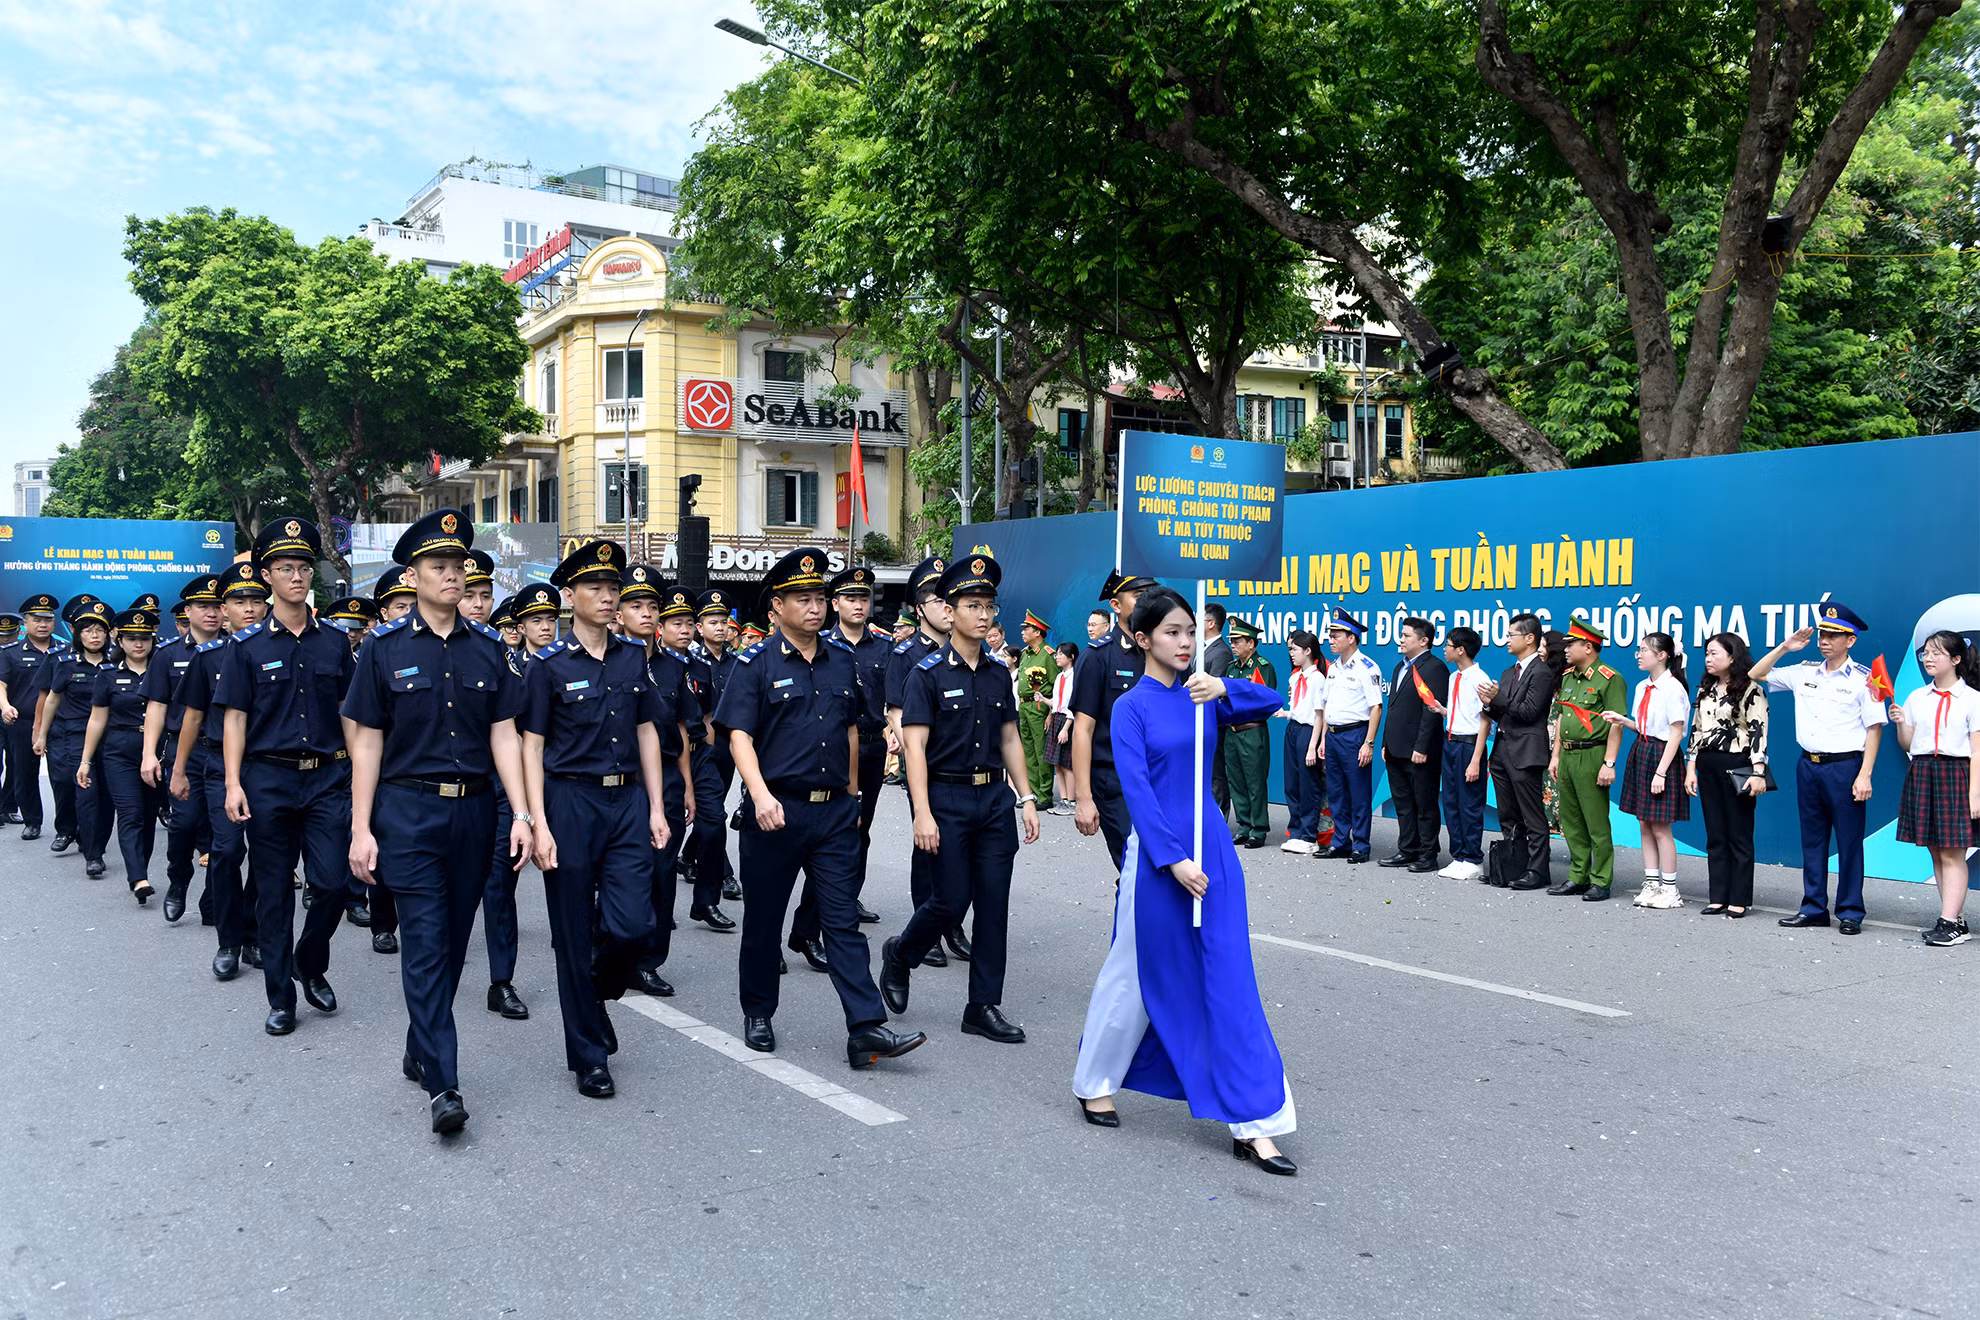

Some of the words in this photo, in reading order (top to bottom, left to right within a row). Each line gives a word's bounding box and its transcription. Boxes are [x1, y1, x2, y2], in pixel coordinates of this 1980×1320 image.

[744, 394, 904, 433] SeABank
[1135, 474, 1157, 495] LỰC
[1160, 475, 1195, 497] LƯỢNG
[1198, 481, 1239, 499] CHUYÊN
[1242, 485, 1276, 502] TRÁCH
[1138, 496, 1179, 516] PHÒNG,
[1182, 498, 1219, 519] CHỐNG
[1222, 502, 1239, 522] TỘI
[1241, 505, 1271, 524] PHẠM
[1158, 515, 1171, 536] VỀ
[1174, 521, 1191, 537] MA
[1194, 520, 1215, 539] TÚY
[1217, 522, 1252, 543] THUỘC
[44, 546, 54, 558] LỄ
[57, 548, 80, 559] KHAI
[82, 548, 104, 560] MẠC
[106, 548, 119, 559] VÀ
[121, 547, 146, 560] TUẦN
[148, 549, 174, 560] HÀNH
[1180, 539, 1199, 559] HẢI
[1202, 544, 1230, 560] QUAN
[4, 560, 33, 571] HƯỞNG
[35, 561, 53, 571] ỨNG
[53, 561, 80, 571] THÁNG
[81, 561, 104, 571] HÀNH
[105, 562, 126, 573] ĐỘNG
[127, 562, 156, 573] PHÒNG,
[156, 562, 182, 573] CHỐNG
[183, 565, 195, 573] MA
[1309, 552, 1370, 601] MẠC
[1381, 543, 1420, 593] VÀ
[1430, 532, 1517, 591] TUẦN
[1530, 534, 1633, 588] HÀNH
[1303, 602, 1369, 645] HÀH
[1375, 601, 1446, 654] ĐỘG
[1693, 604, 1751, 648] MA
